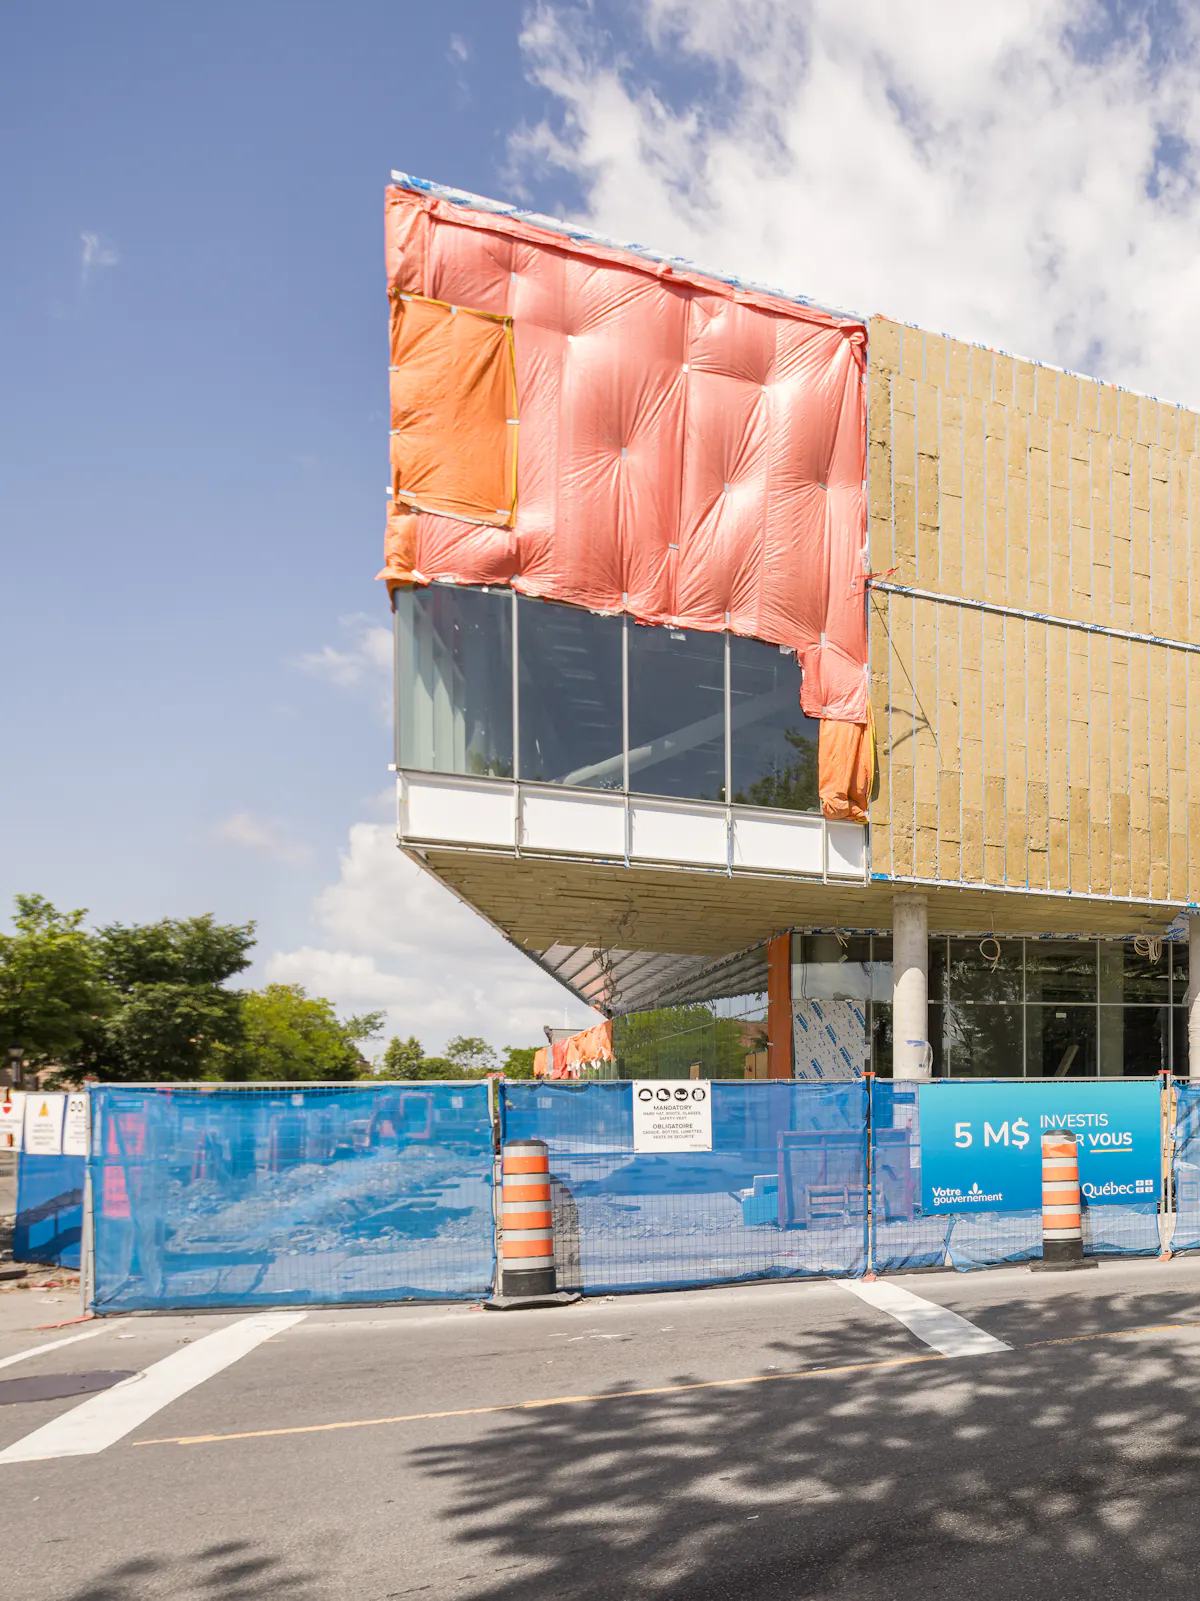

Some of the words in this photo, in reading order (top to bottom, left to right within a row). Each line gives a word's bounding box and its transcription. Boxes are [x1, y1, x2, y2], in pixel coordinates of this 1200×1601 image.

[1040, 1113, 1109, 1128] INVESTIS
[954, 1122, 973, 1148] 5
[983, 1116, 1030, 1150] M$
[1088, 1131, 1133, 1147] VOUS
[932, 1187, 961, 1197] Votre
[1081, 1181, 1134, 1198] Québec
[933, 1192, 1003, 1206] gouvernement
